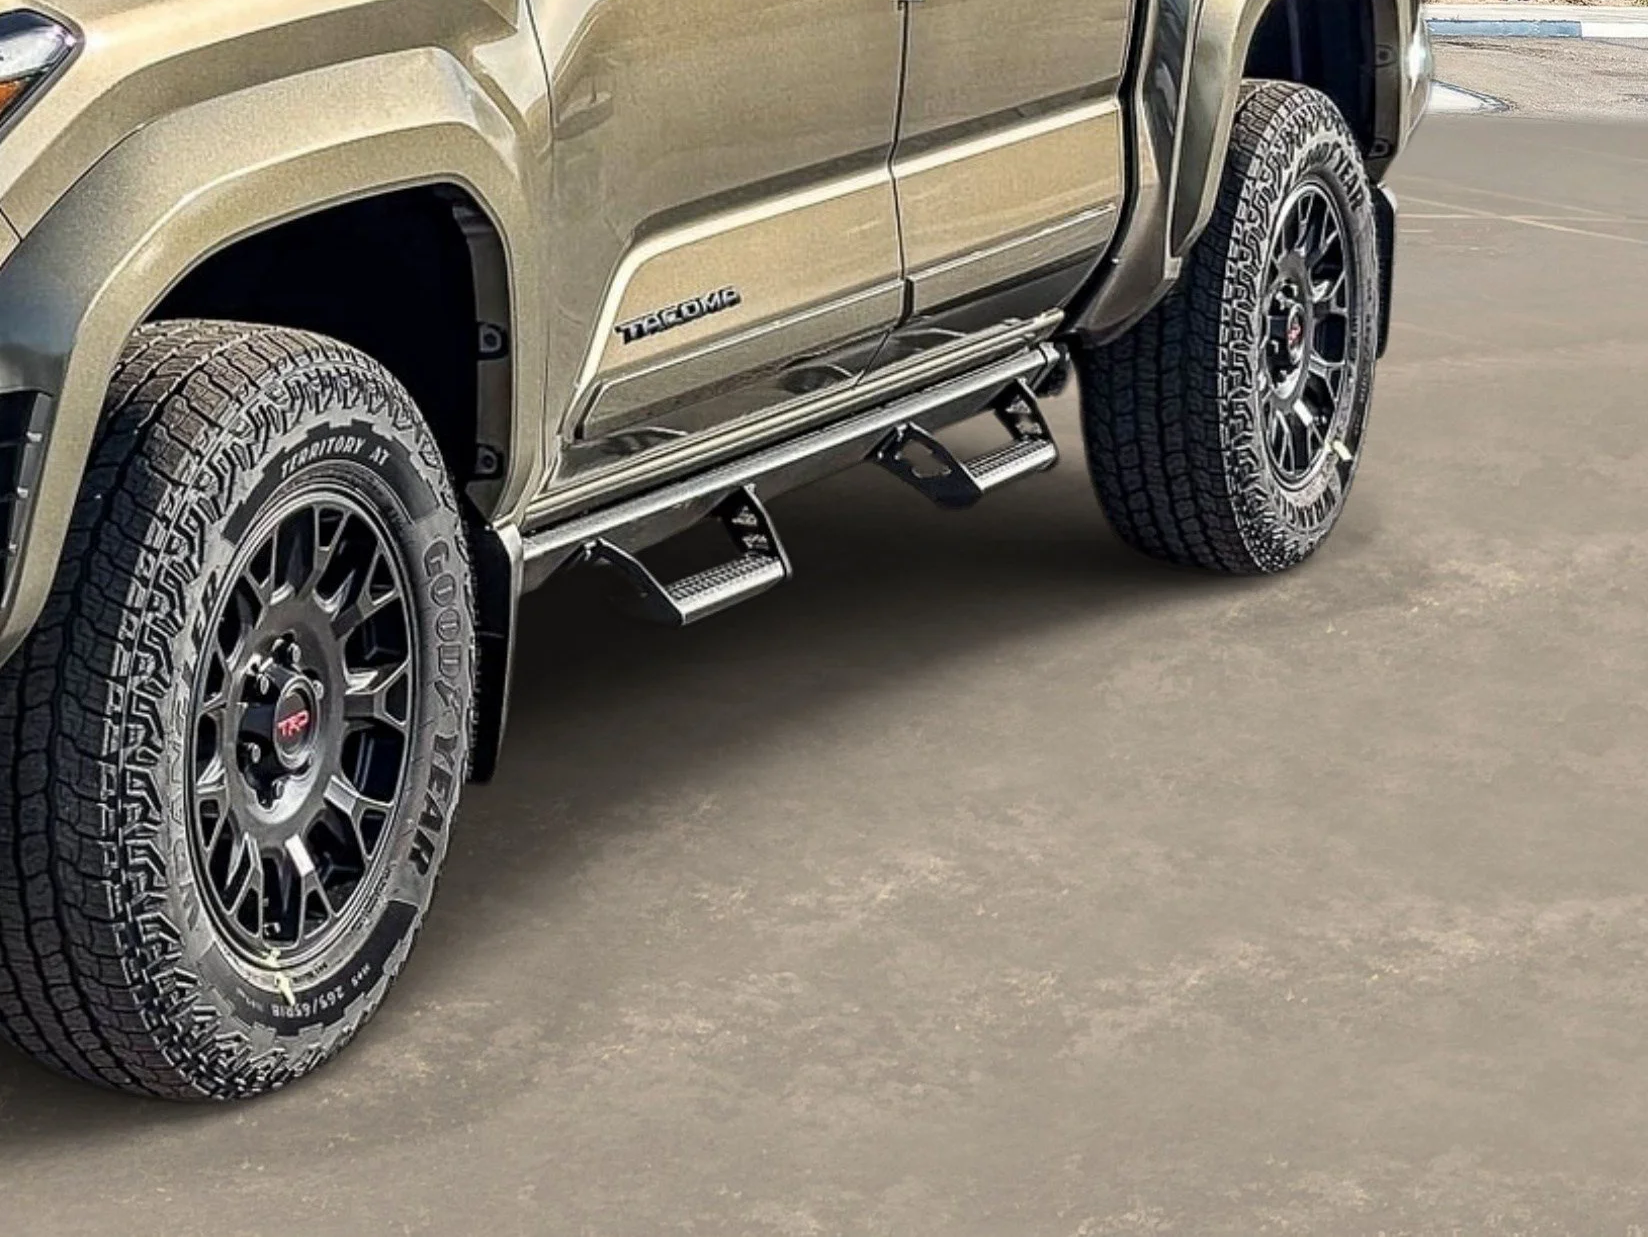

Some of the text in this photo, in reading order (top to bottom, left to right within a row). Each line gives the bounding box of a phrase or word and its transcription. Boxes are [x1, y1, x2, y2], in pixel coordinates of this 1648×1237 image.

[615, 285, 743, 345] TACOMA
[281, 434, 391, 479] TERRITORY AT
[278, 710, 309, 737] TRD
[408, 538, 463, 877] GOODYEAR
[271, 984, 346, 1019] 265/65R18
